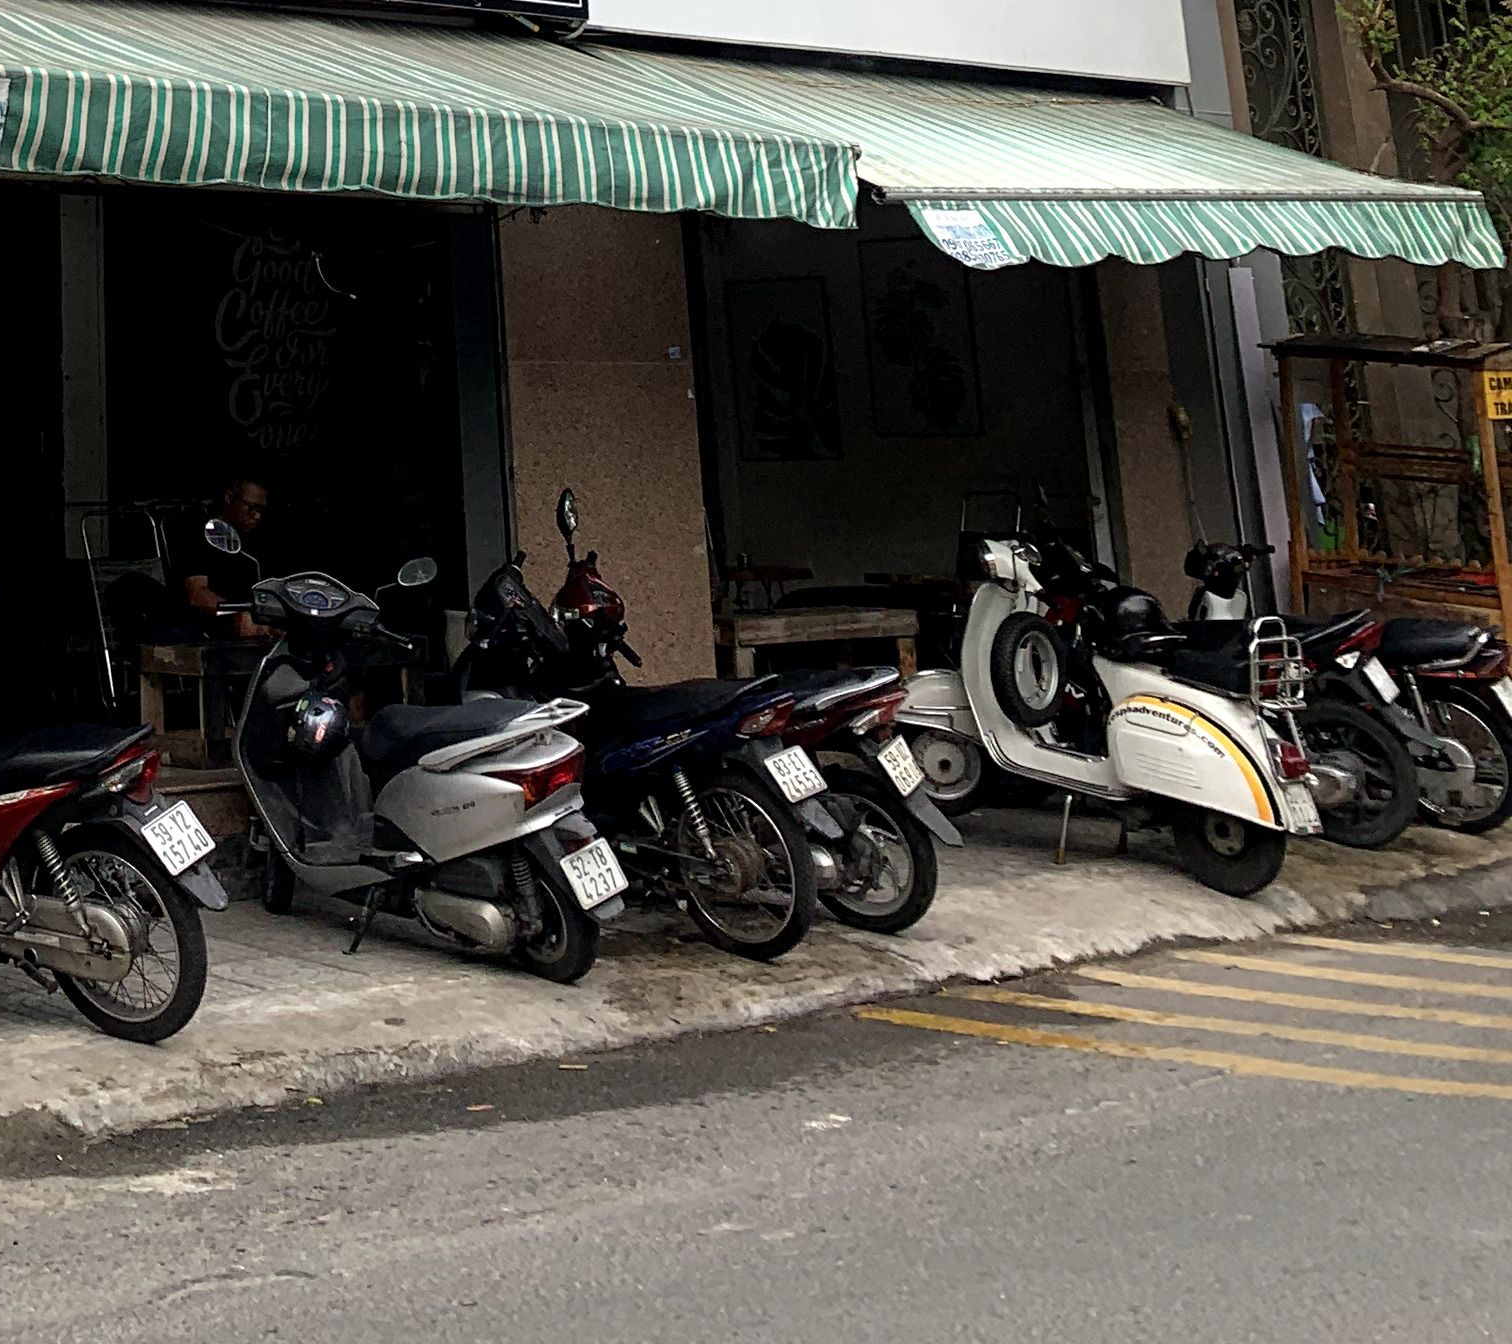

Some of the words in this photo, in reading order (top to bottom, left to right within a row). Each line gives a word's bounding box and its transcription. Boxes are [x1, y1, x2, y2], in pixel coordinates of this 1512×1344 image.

[1108, 705, 1226, 759] espaadventures.com
[150, 810, 191, 845] 59-Y2
[162, 828, 209, 870] 157.40
[569, 846, 607, 880] 52-T8
[581, 867, 617, 901] 4237
